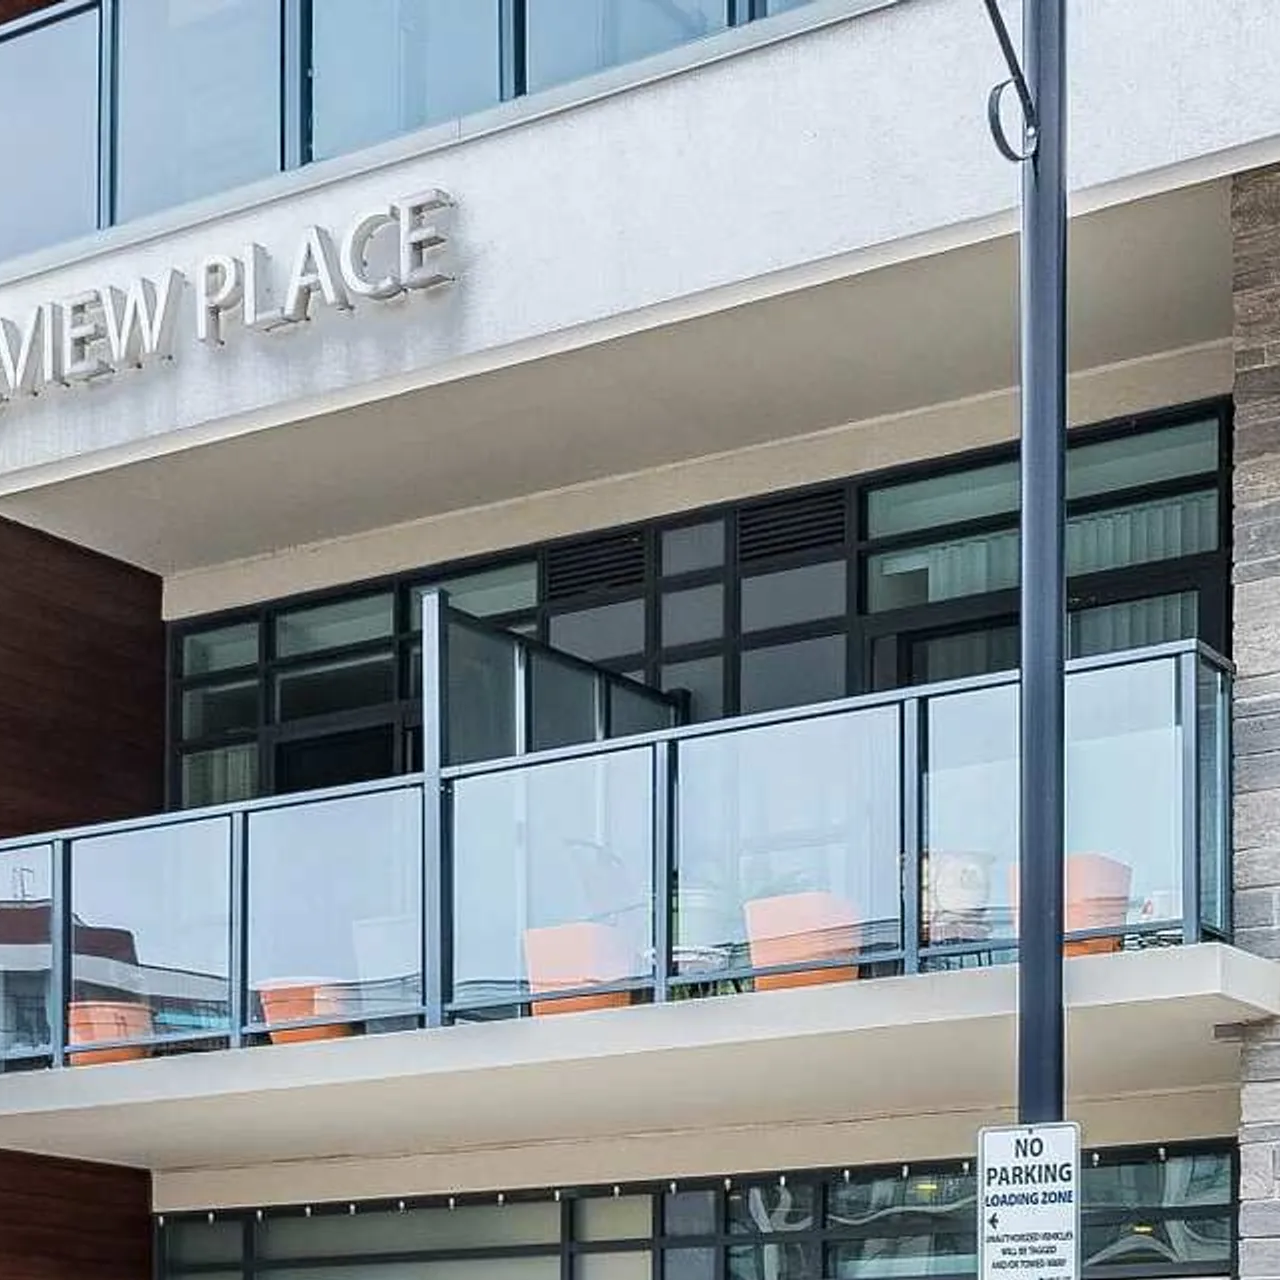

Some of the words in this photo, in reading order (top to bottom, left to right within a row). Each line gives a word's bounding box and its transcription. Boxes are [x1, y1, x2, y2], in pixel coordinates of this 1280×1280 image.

[195, 188, 457, 347] PLACE
[1014, 1137, 1044, 1158] NO
[986, 1163, 1073, 1187] PARKING
[985, 1192, 1039, 1207] LOADING
[1041, 1190, 1073, 1205] ZONE
